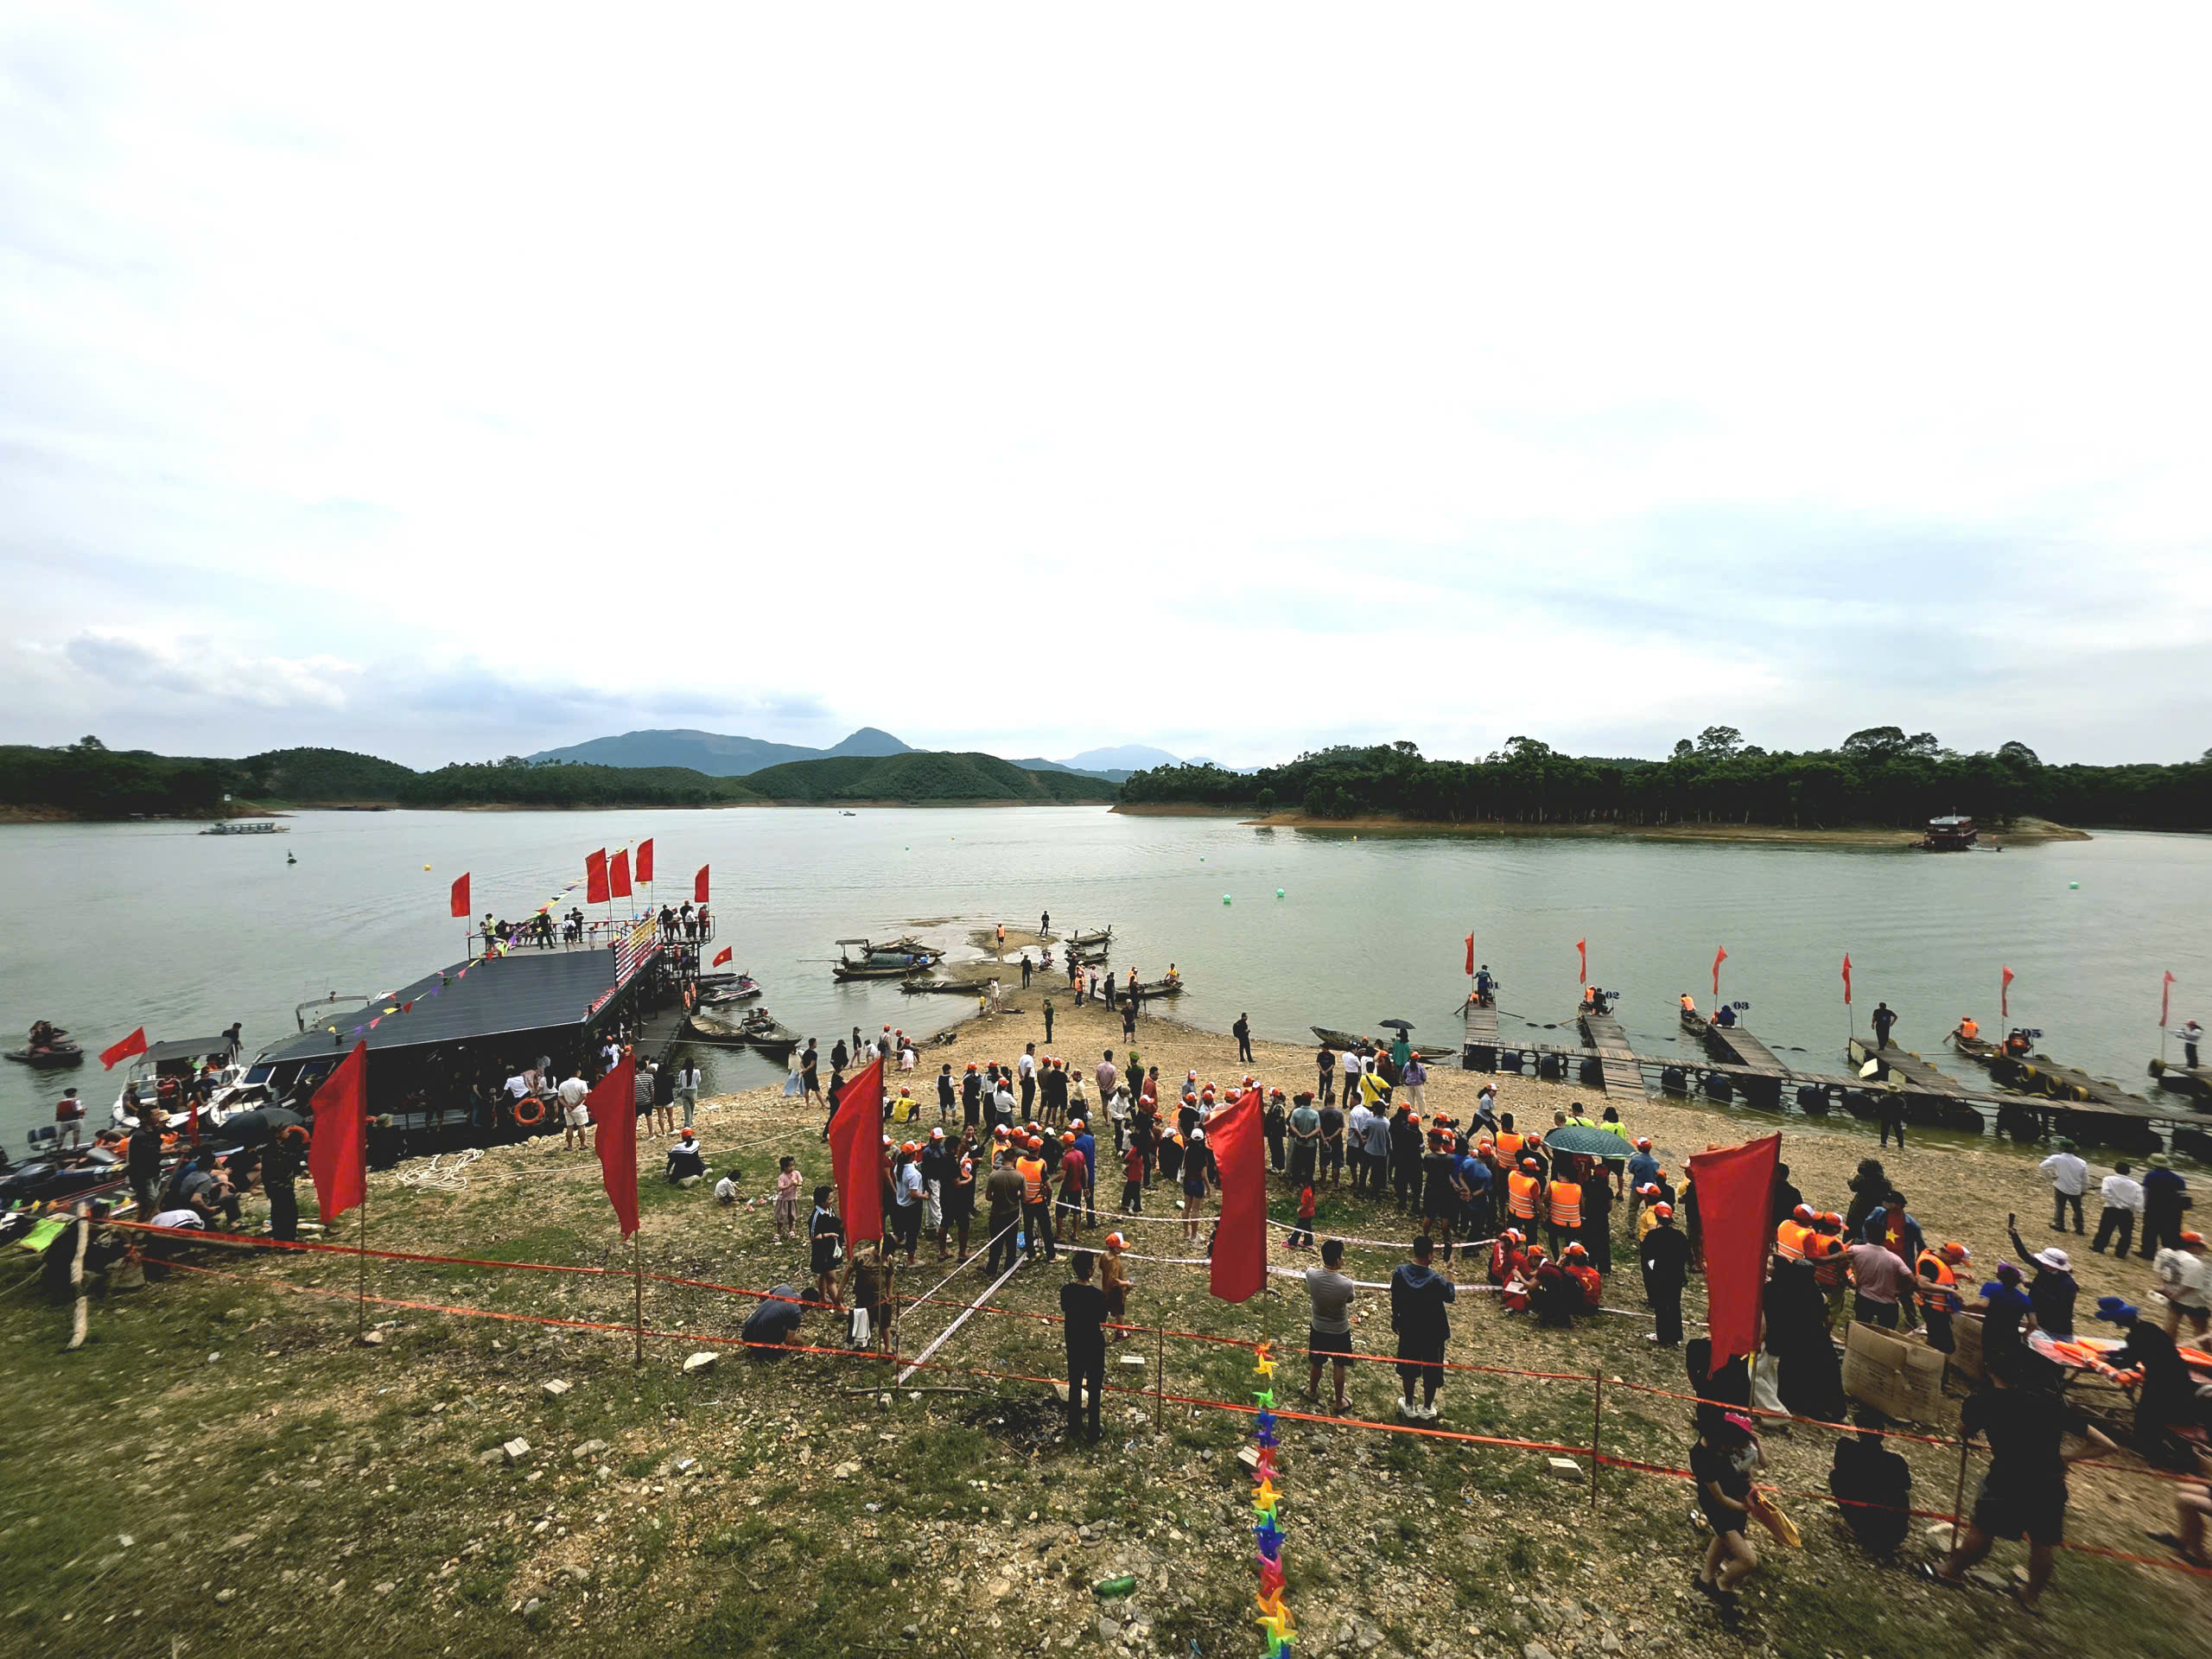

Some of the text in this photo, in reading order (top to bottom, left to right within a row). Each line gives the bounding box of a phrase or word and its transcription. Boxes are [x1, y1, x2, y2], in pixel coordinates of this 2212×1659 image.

[1605, 990, 1620, 1000] 02
[1733, 1001, 1750, 1010] 03
[2022, 1028, 2041, 1039] 05
